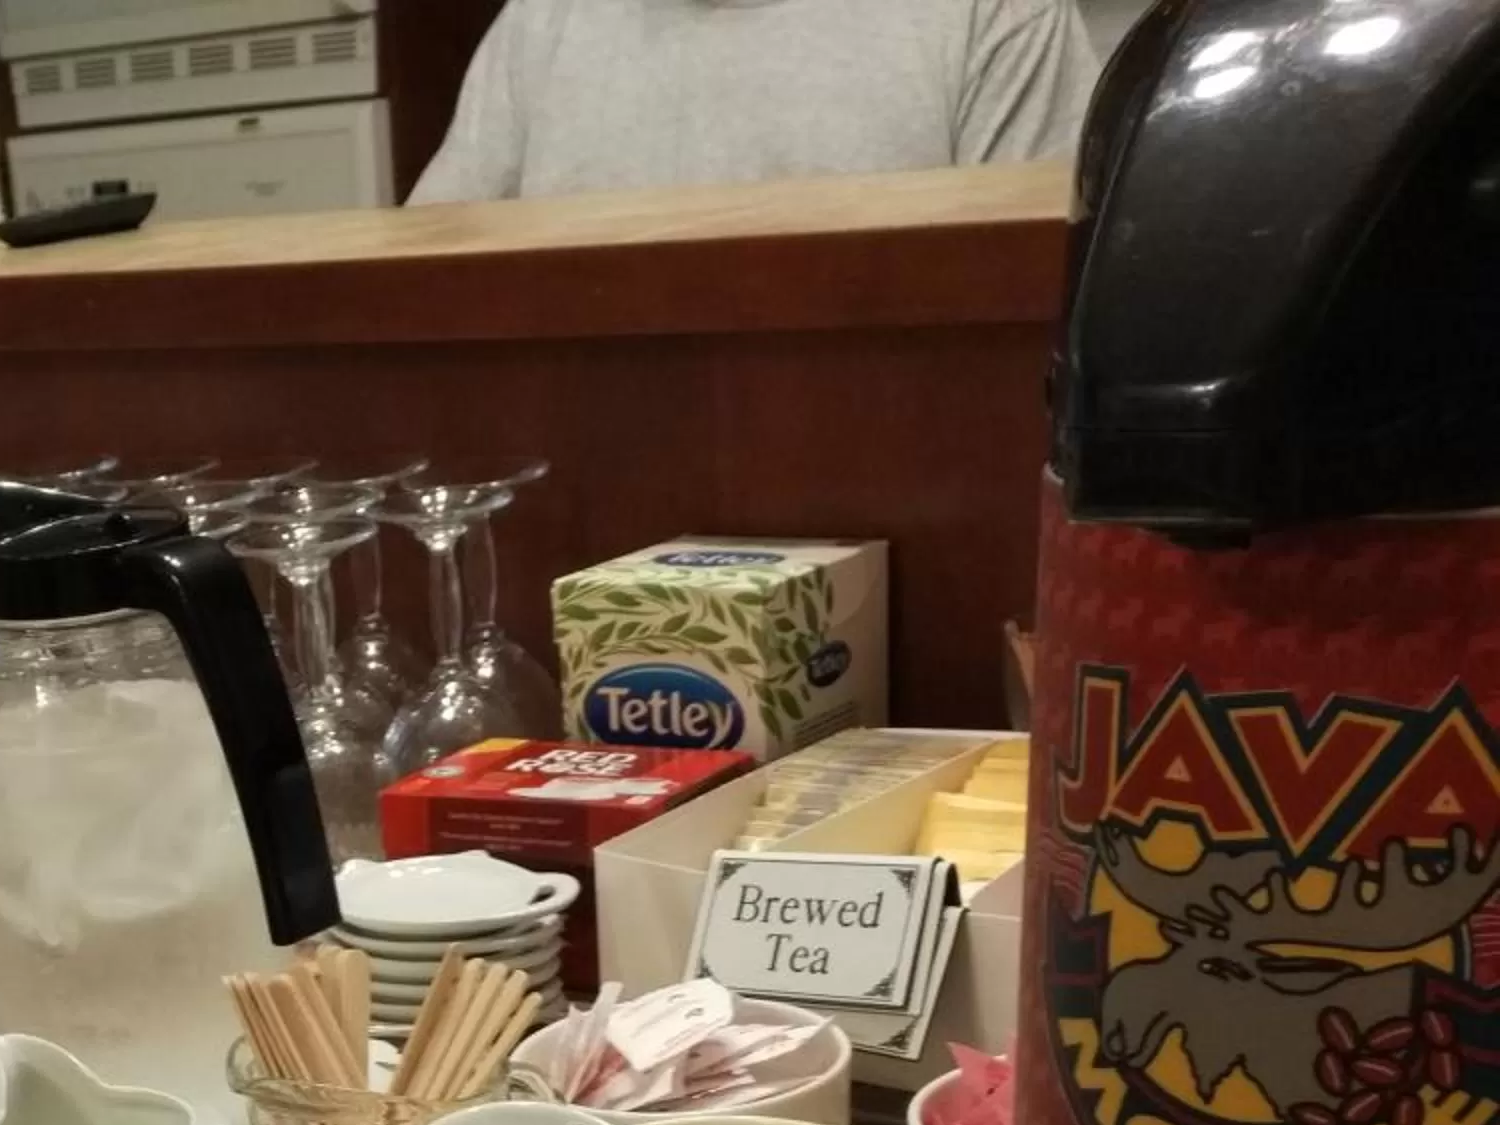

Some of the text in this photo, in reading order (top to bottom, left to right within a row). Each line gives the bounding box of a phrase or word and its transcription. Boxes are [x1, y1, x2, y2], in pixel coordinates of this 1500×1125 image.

[597, 686, 735, 750] Tetley
[504, 758, 634, 777] ROSE
[542, 748, 638, 765] RED
[1058, 672, 1500, 862] JAVA
[732, 883, 885, 930] Brewed
[765, 932, 832, 976] Tea
